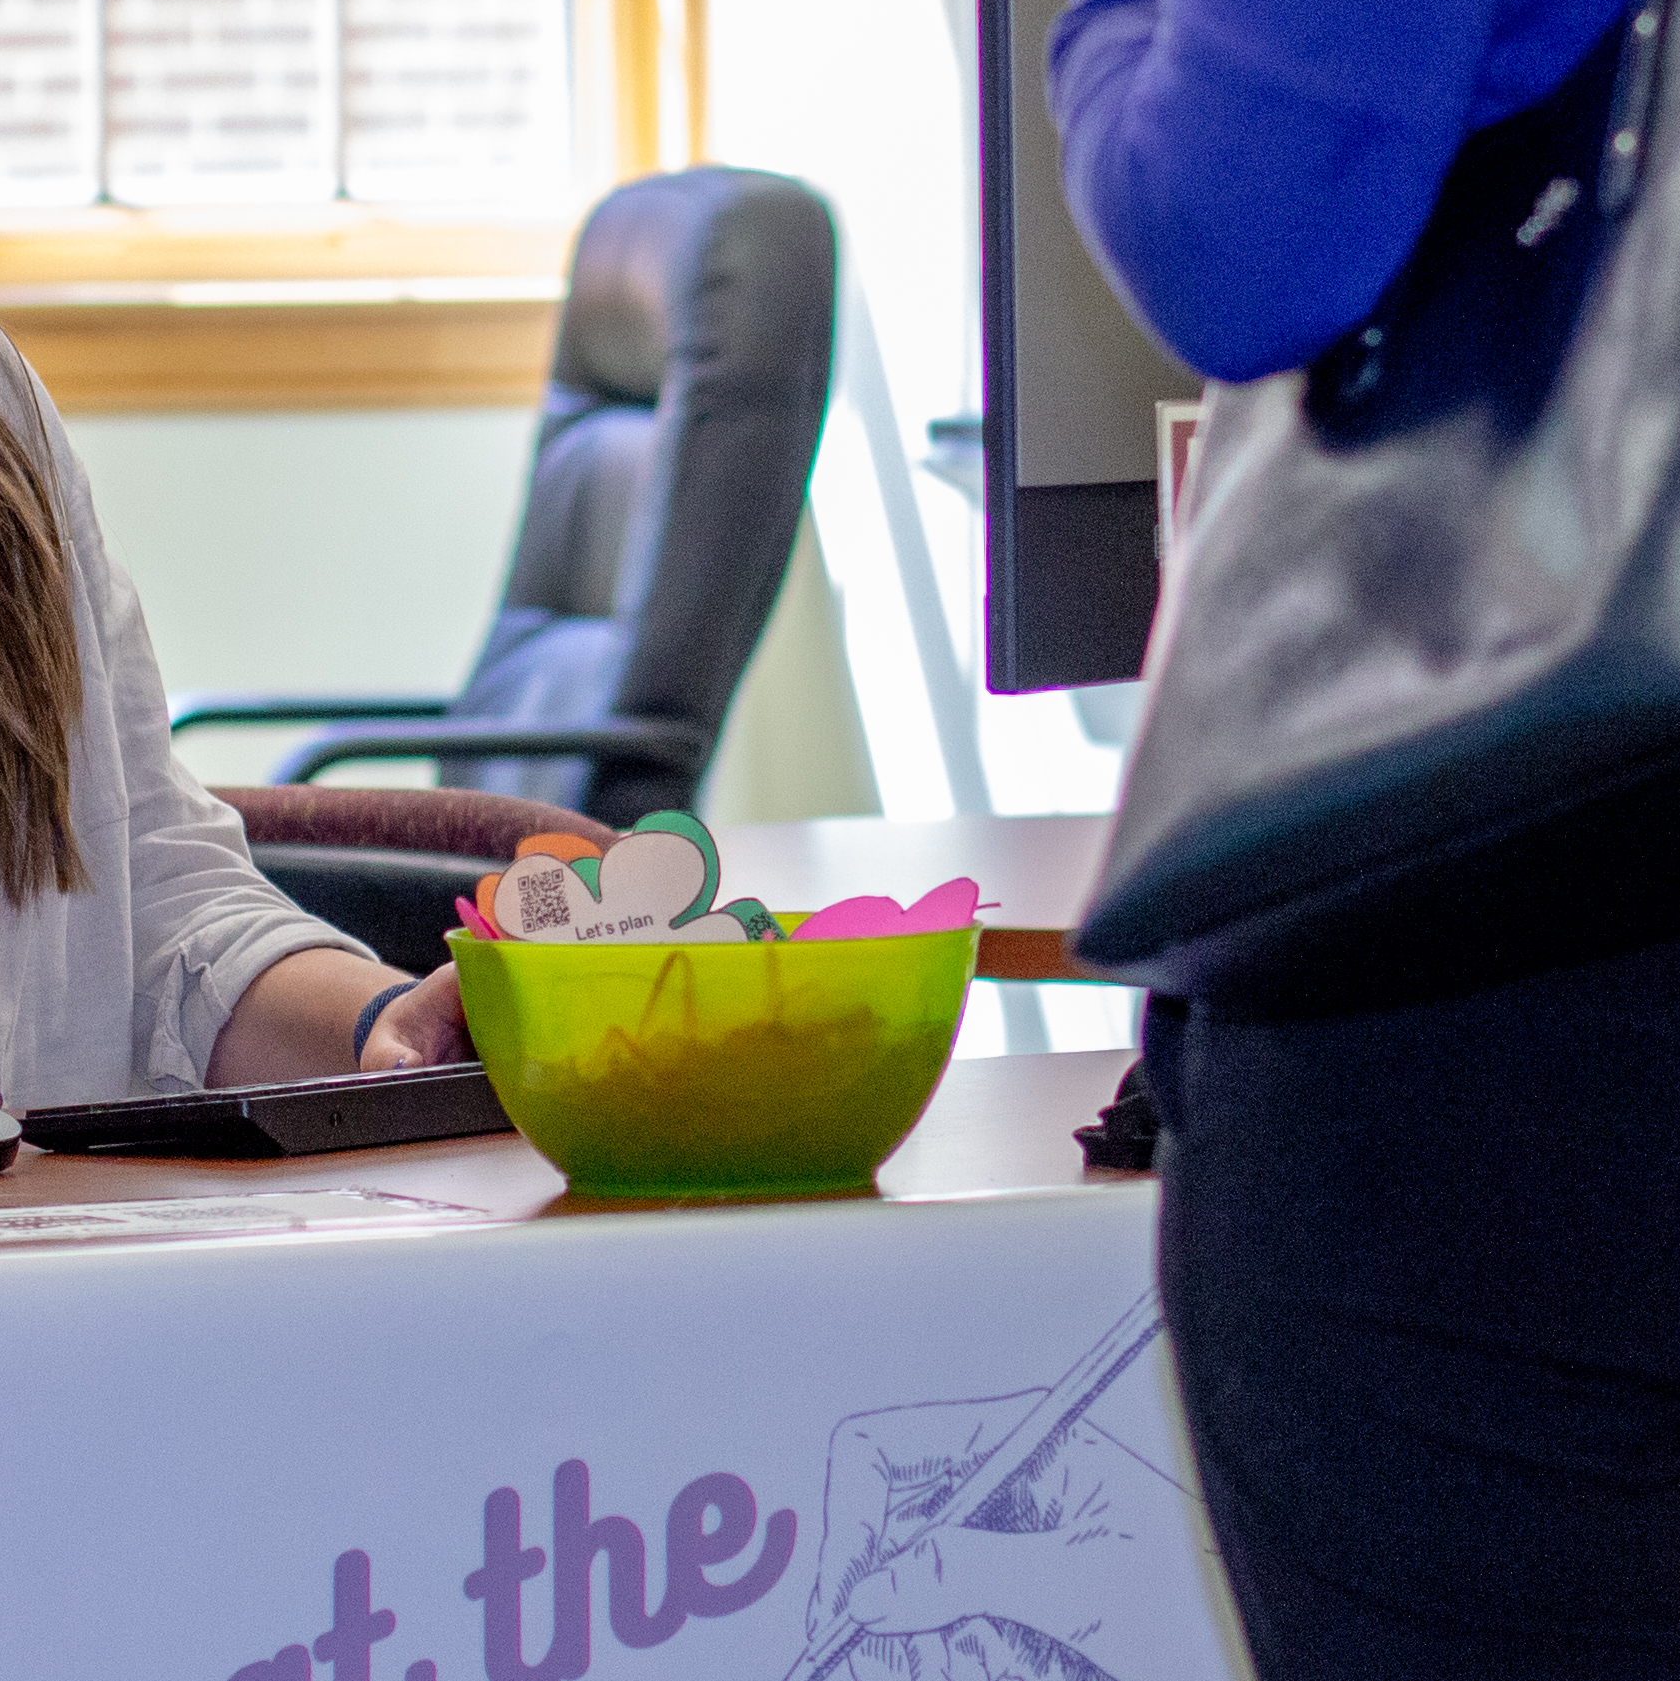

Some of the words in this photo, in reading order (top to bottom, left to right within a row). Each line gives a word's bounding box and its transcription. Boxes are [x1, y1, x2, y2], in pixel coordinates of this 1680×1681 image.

[574, 921, 616, 941] Let's
[618, 914, 654, 936] plan
[462, 1457, 799, 1681] the
